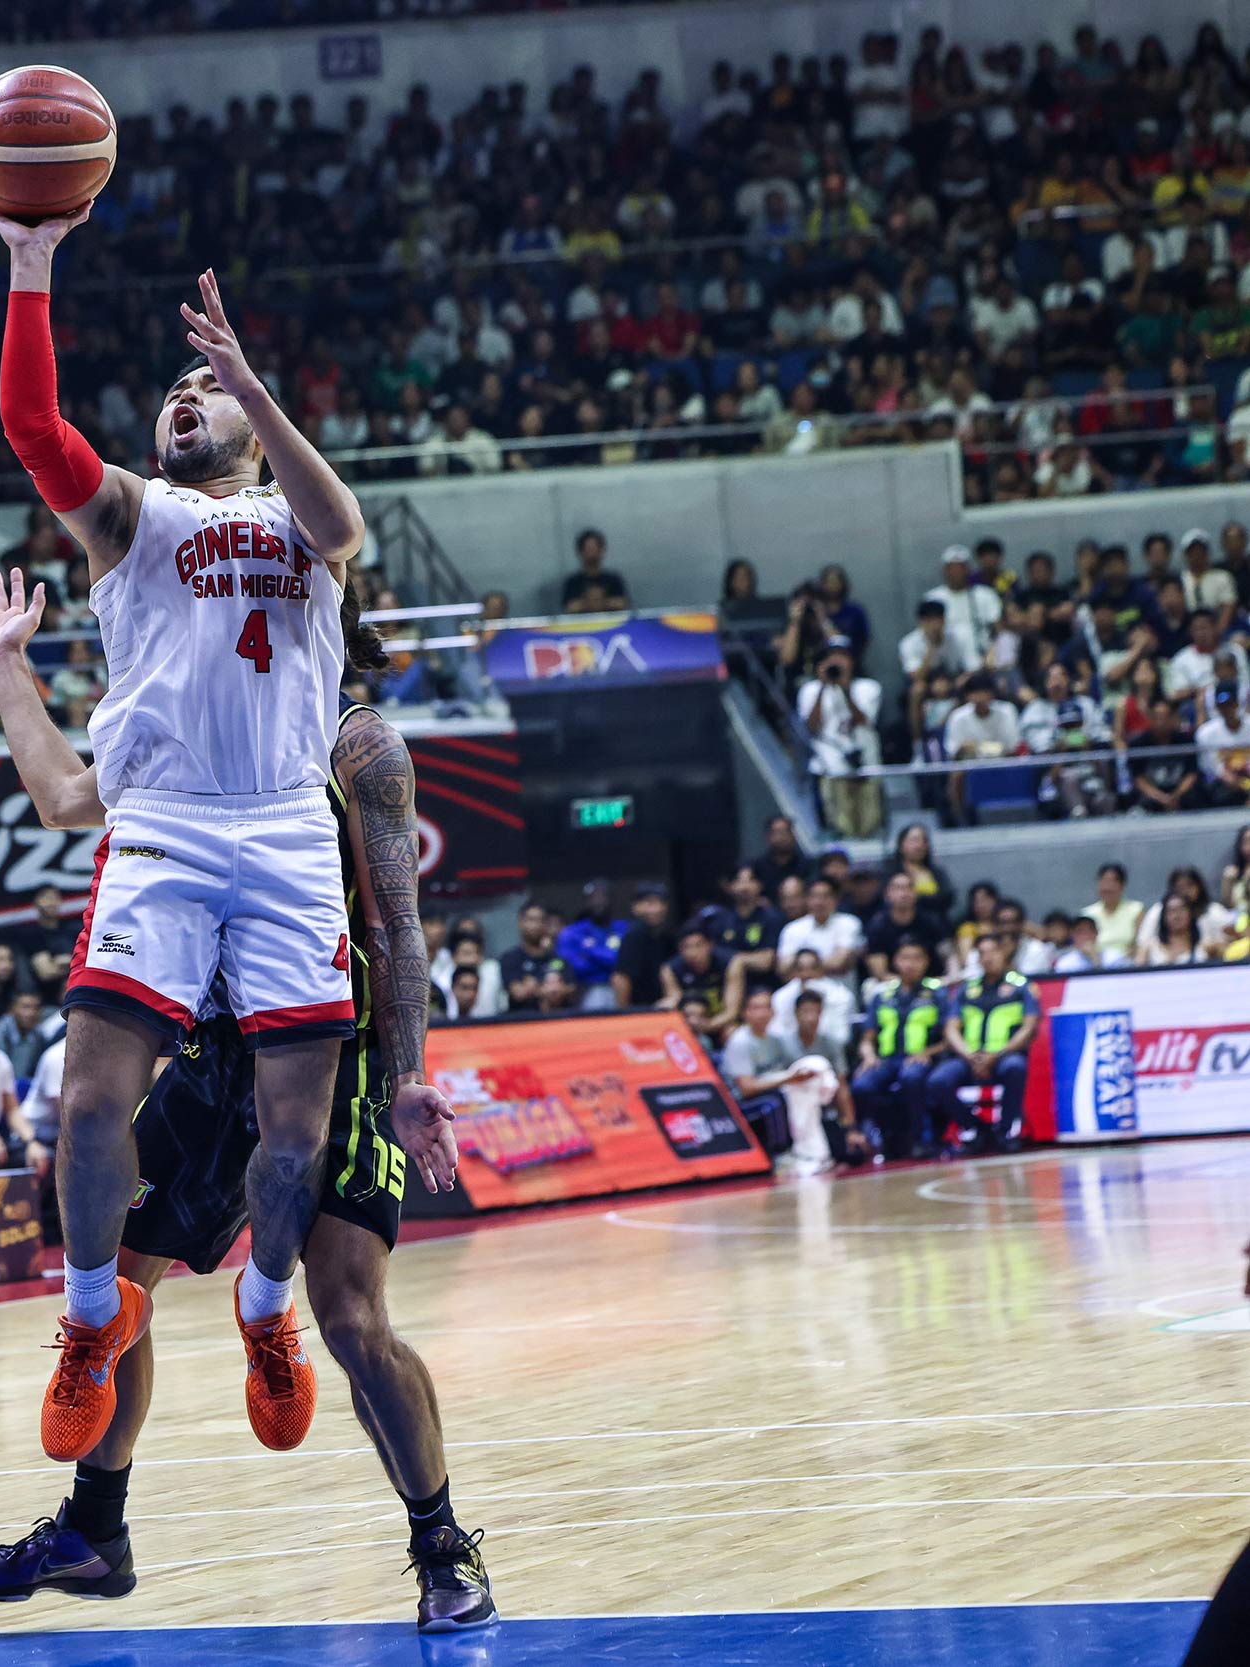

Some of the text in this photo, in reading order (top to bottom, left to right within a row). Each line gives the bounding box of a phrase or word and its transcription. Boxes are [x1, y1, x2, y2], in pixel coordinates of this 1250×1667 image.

[1, 111, 71, 126] molten
[192, 574, 310, 600] SAN MIGUEL
[235, 609, 273, 674] 4
[102, 942, 132, 950] WORLD
[1136, 1032, 1200, 1073] ulit
